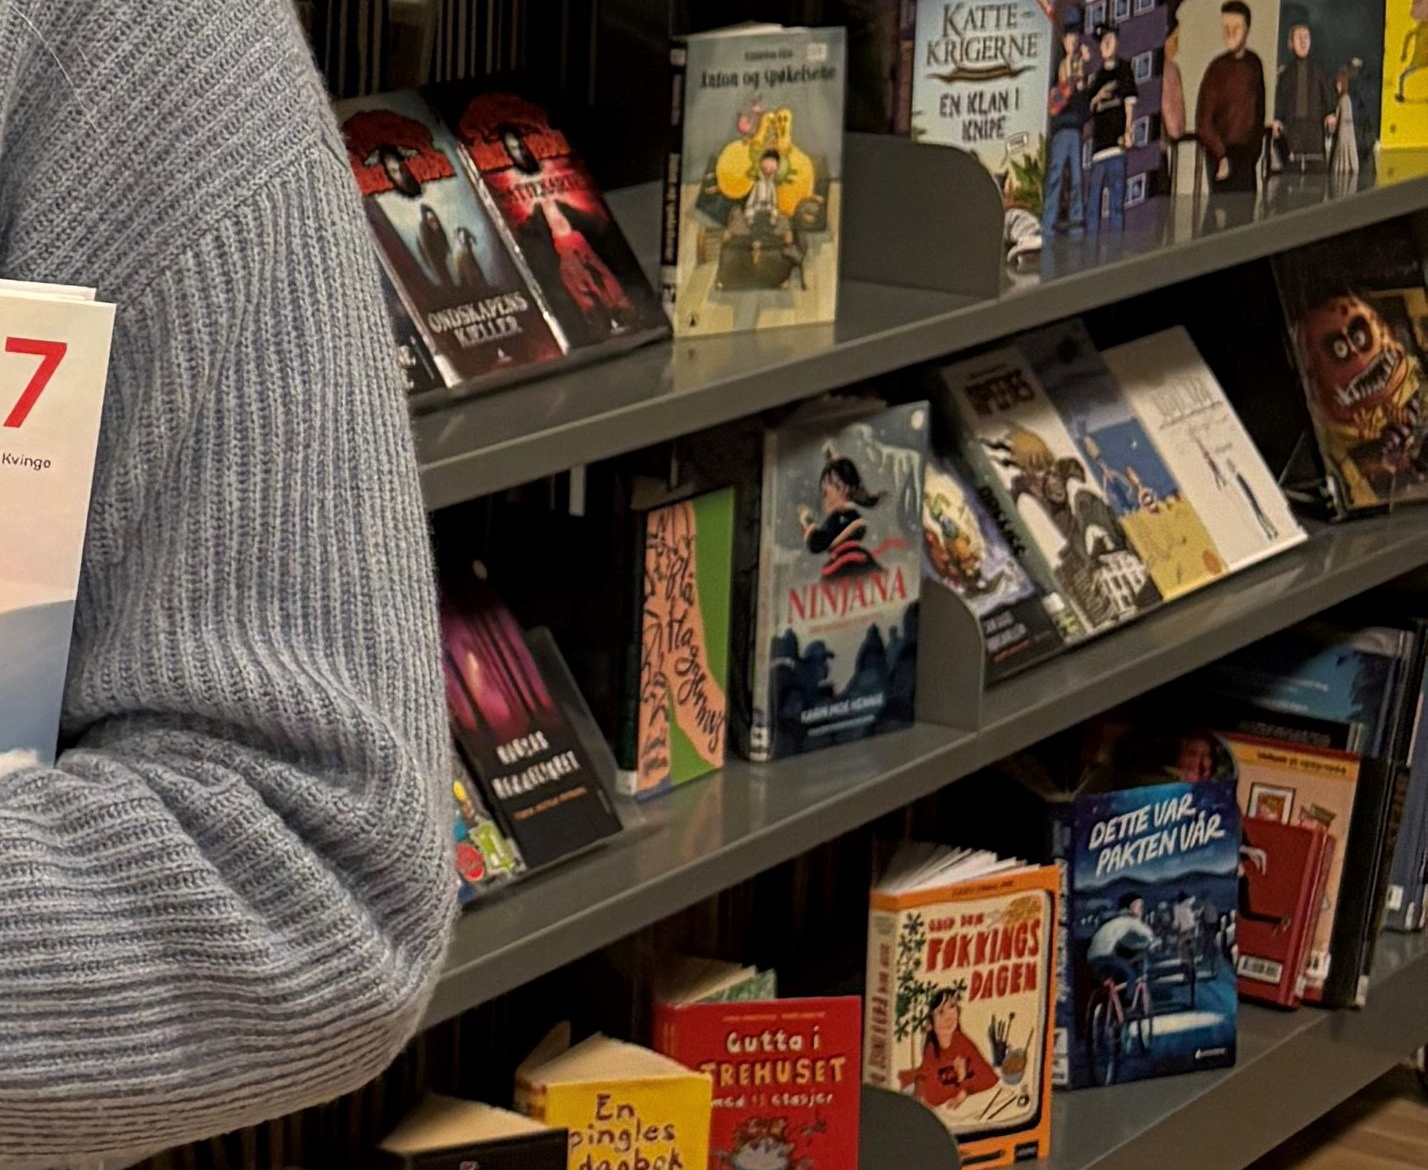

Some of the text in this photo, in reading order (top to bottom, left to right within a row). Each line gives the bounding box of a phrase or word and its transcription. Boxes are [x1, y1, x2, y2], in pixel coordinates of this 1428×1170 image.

[926, 31, 1040, 68] KRIGERNE
[939, 92, 962, 118] EN
[967, 89, 1009, 116] KLAN
[961, 114, 1007, 143] KNIPE
[2, 336, 68, 429] 7
[2, 452, 52, 471] Kvinge
[787, 565, 907, 626] NINJANA
[1088, 792, 1197, 851] DETTE VAR
[1095, 810, 1226, 878] PAKTEN VÅR
[967, 960, 1038, 1003] DAGEN
[726, 1029, 804, 1054] Gutta
[700, 1055, 847, 1088] TREHUSET
[595, 1093, 635, 1122] En
[568, 1117, 676, 1154] pingles
